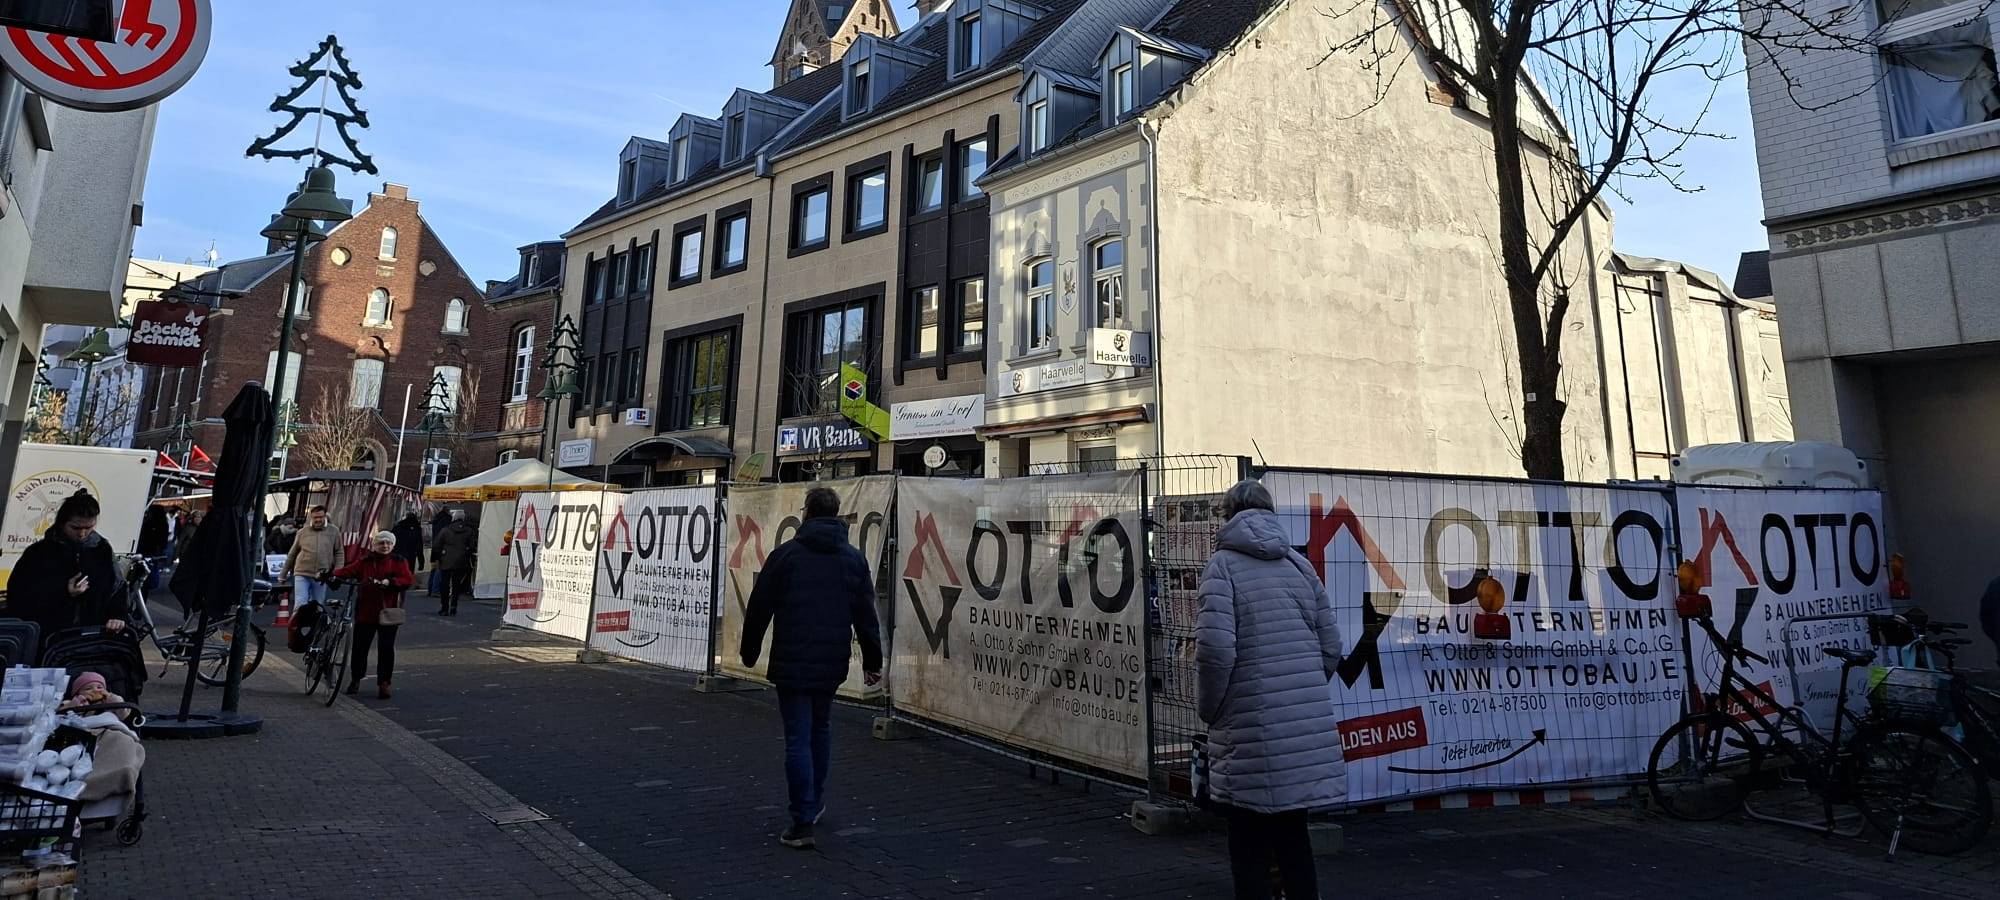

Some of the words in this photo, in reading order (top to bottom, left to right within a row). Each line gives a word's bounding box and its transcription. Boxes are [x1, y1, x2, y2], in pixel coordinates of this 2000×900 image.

[132, 330, 201, 348] Schmidt
[140, 320, 198, 336] Bäcker
[1096, 349, 1147, 364] Haarwelle
[1041, 363, 1084, 380] Haarwelle
[895, 405, 927, 421] Genuss
[930, 406, 943, 418] im
[947, 397, 977, 420] Dorf
[801, 426, 820, 449] VR
[825, 425, 863, 447] Bank
[15, 474, 84, 502] Mühlenbäck
[544, 503, 599, 551] OTTO
[636, 504, 712, 563] OTTO
[966, 517, 1134, 614] OTTO
[1423, 507, 1664, 604] OTTO
[1760, 511, 1880, 595] OTTO
[969, 606, 1137, 646] BAUUNTERNEHMEN
[1416, 608, 1667, 635] BAUTERNEHMEN
[1766, 628, 1776, 644] A.
[1804, 625, 1812, 641] &
[1853, 618, 1861, 632] &
[970, 632, 980, 648] A.
[984, 633, 1005, 651] Otto
[1008, 637, 1014, 653] &
[1017, 639, 1044, 657] Sohn
[1048, 643, 1079, 665] GmbH
[1084, 648, 1092, 665] &
[1096, 650, 1116, 670] Co.
[1120, 652, 1140, 673] KG
[1421, 643, 1438, 662] A.
[1443, 643, 1478, 661] Otto
[1486, 642, 1497, 660] &
[1502, 642, 1544, 659] Sohn
[1551, 640, 1602, 658] GmbH
[1608, 639, 1618, 656] &
[1624, 637, 1652, 655] Co.
[972, 652, 1138, 704] WWW.OTTOBAU.DE
[972, 676, 987, 692] Tel:
[990, 681, 1040, 705] 0214-87500
[1052, 694, 1139, 727] info@ottobau.de
[1429, 700, 1456, 717] Tel:
[1462, 694, 1547, 714] 0214-87500
[1386, 720, 1417, 743] AUS
[1441, 743, 1468, 764] Jetzt
[1469, 734, 1512, 754] bewerben
